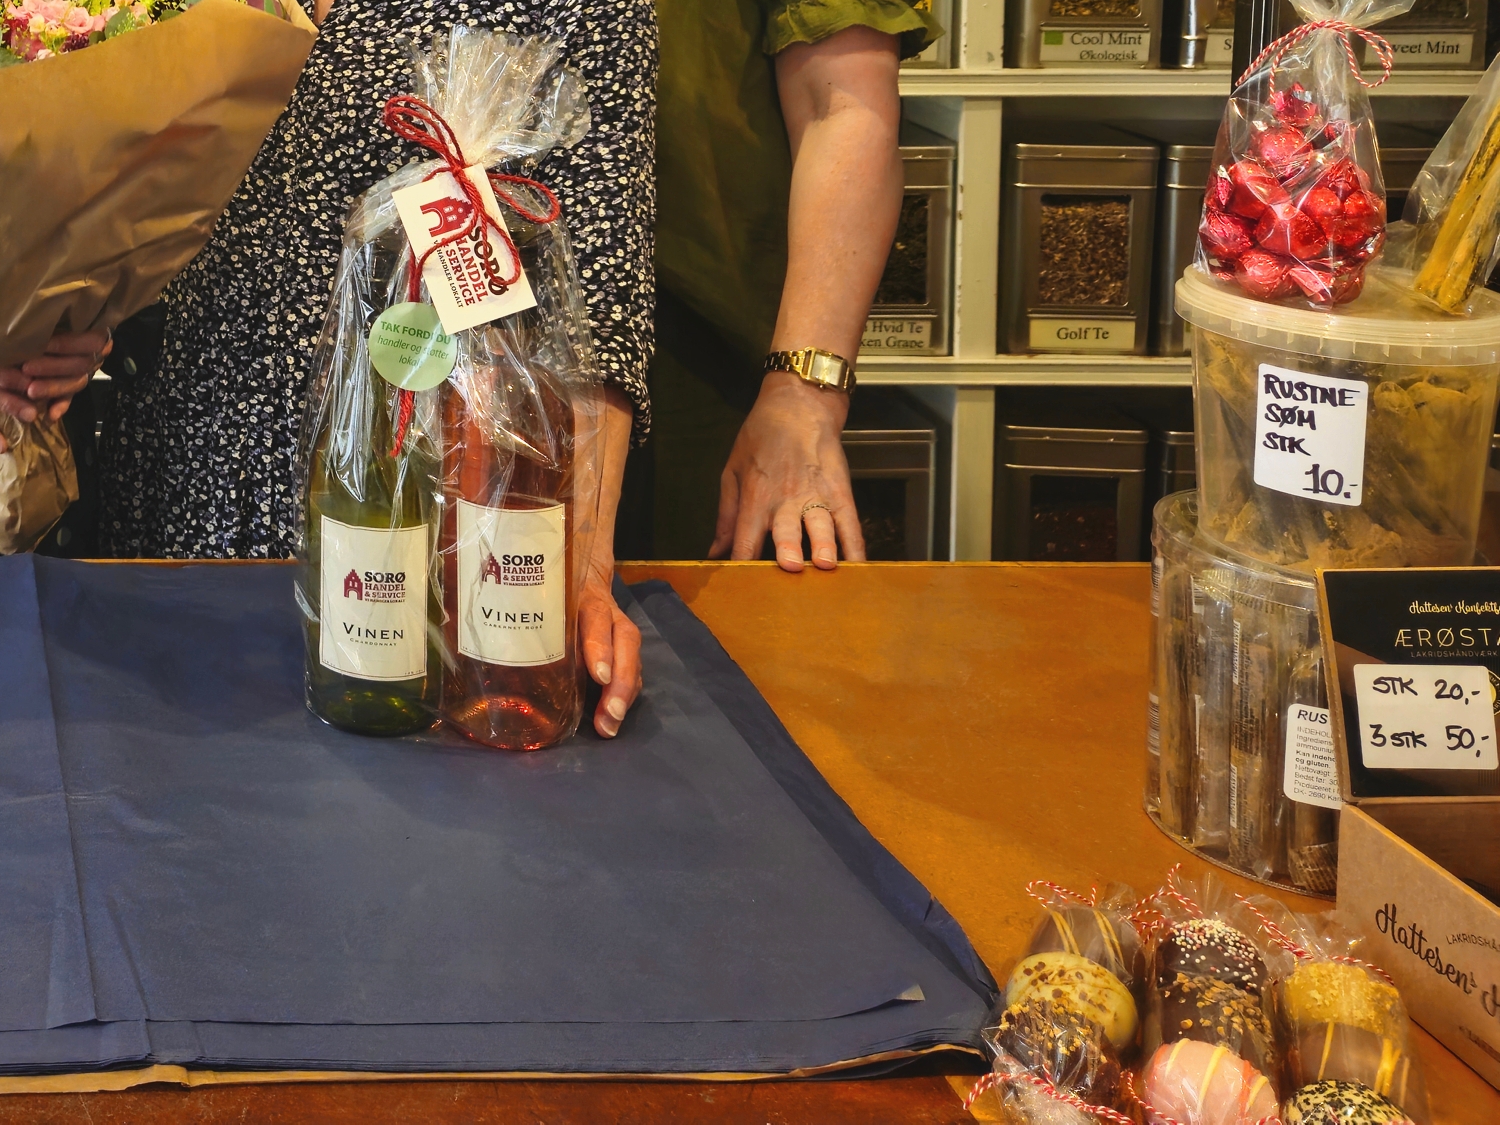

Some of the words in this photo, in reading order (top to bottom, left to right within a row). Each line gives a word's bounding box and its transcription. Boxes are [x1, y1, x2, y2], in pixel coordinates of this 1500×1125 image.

[1071, 33, 1103, 46] Cool
[1109, 33, 1142, 46] Mint
[1425, 41, 1460, 54] Mint
[1079, 49, 1138, 61] Økologisk
[455, 237, 488, 302] HANDEL
[437, 249, 451, 282] HANDLER
[450, 282, 464, 308] LOKALT
[446, 250, 475, 307] SERVICE
[381, 321, 400, 334] TAK
[872, 321, 904, 333] Hvid
[908, 322, 923, 334] Te
[1056, 327, 1088, 340] Golf
[1092, 327, 1109, 340] Te
[378, 335, 410, 350] handler
[411, 345, 422, 355] og
[1263, 374, 1360, 407] RUSTNE
[1264, 403, 1317, 431] SØM
[1262, 432, 1311, 457] STK
[502, 554, 544, 566] SORØ
[502, 566, 545, 574] HANDEL
[364, 571, 406, 584] SORØ
[510, 574, 545, 582] SERVICE
[364, 583, 406, 592] HANDEL
[372, 591, 406, 599] SERVICE
[481, 606, 544, 623] VINEN
[342, 622, 404, 640] VINEN
[1411, 649, 1499, 658] LAKRIDSHÅNDVÆRK
[1372, 676, 1418, 697] STK
[1434, 678, 1481, 706] 20,-
[1445, 724, 1490, 758] 50,-
